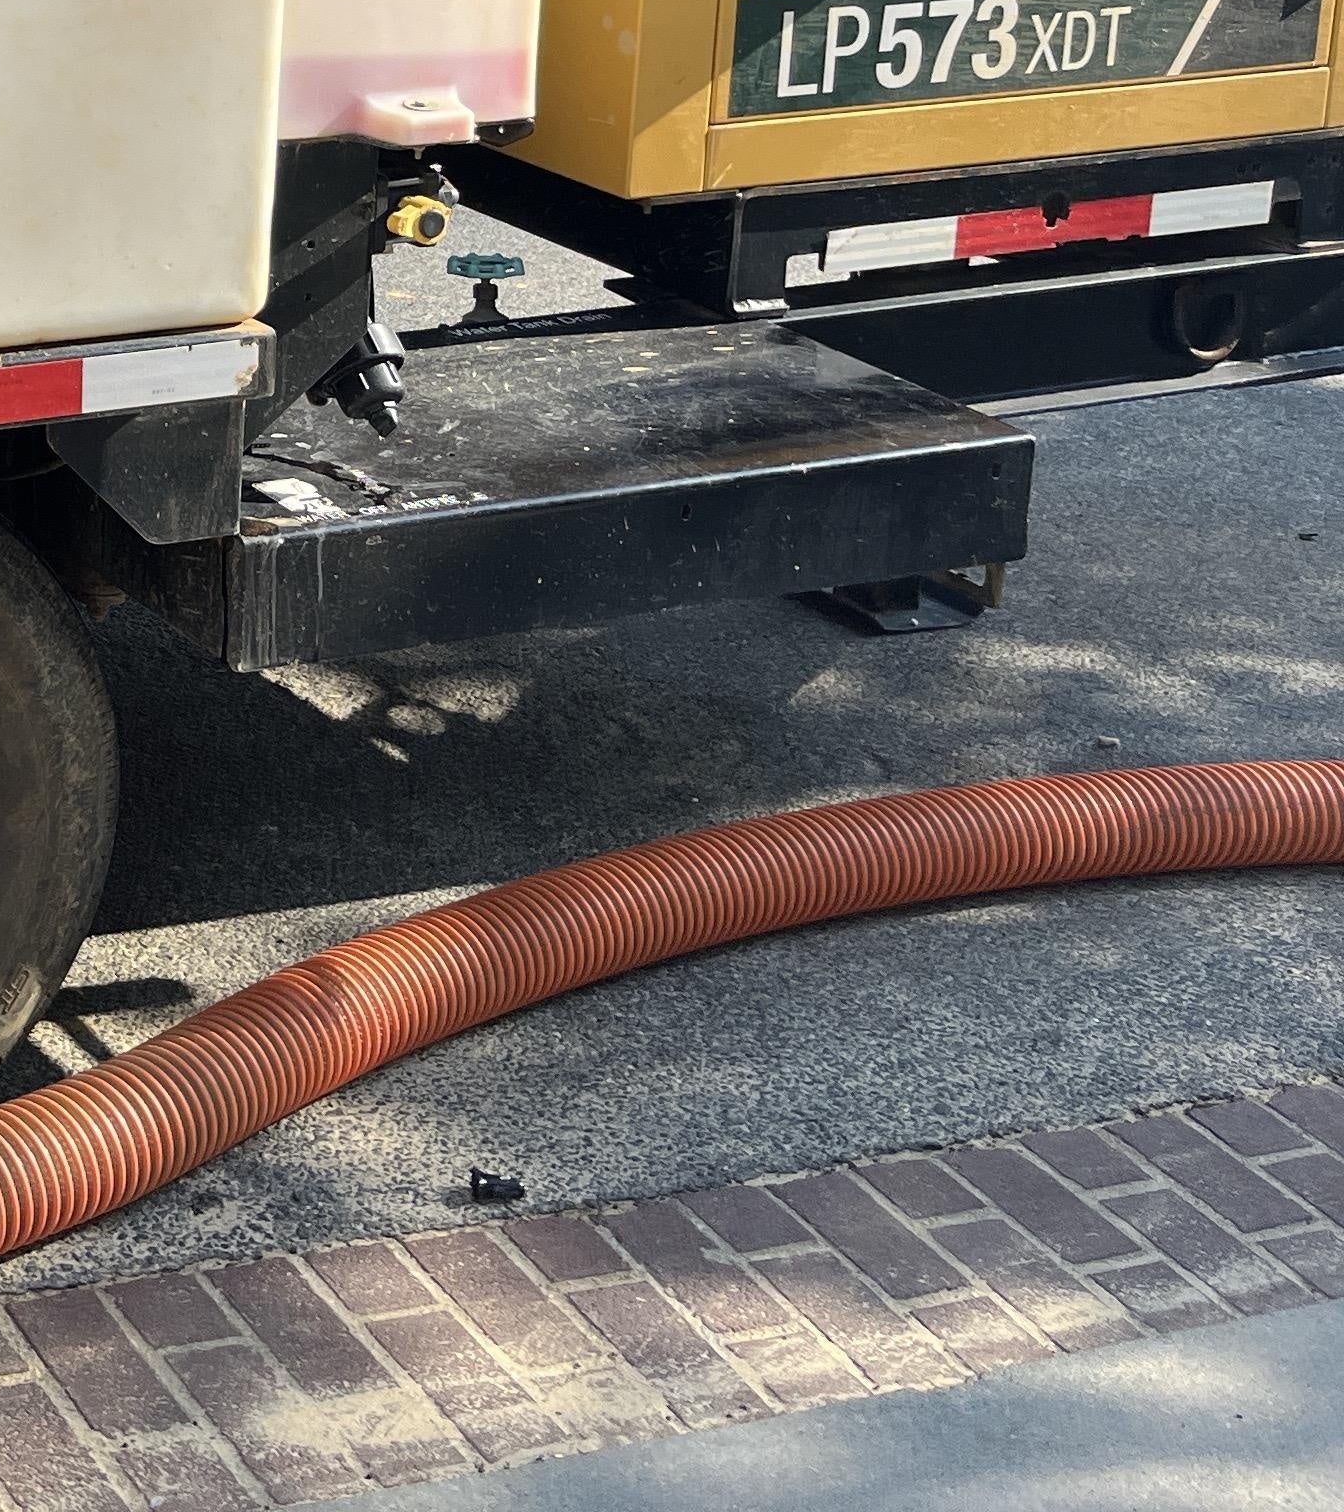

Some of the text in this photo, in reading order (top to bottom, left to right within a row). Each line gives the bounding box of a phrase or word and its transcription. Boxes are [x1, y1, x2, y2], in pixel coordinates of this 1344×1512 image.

[448, 311, 612, 337] Water Tank Drain
